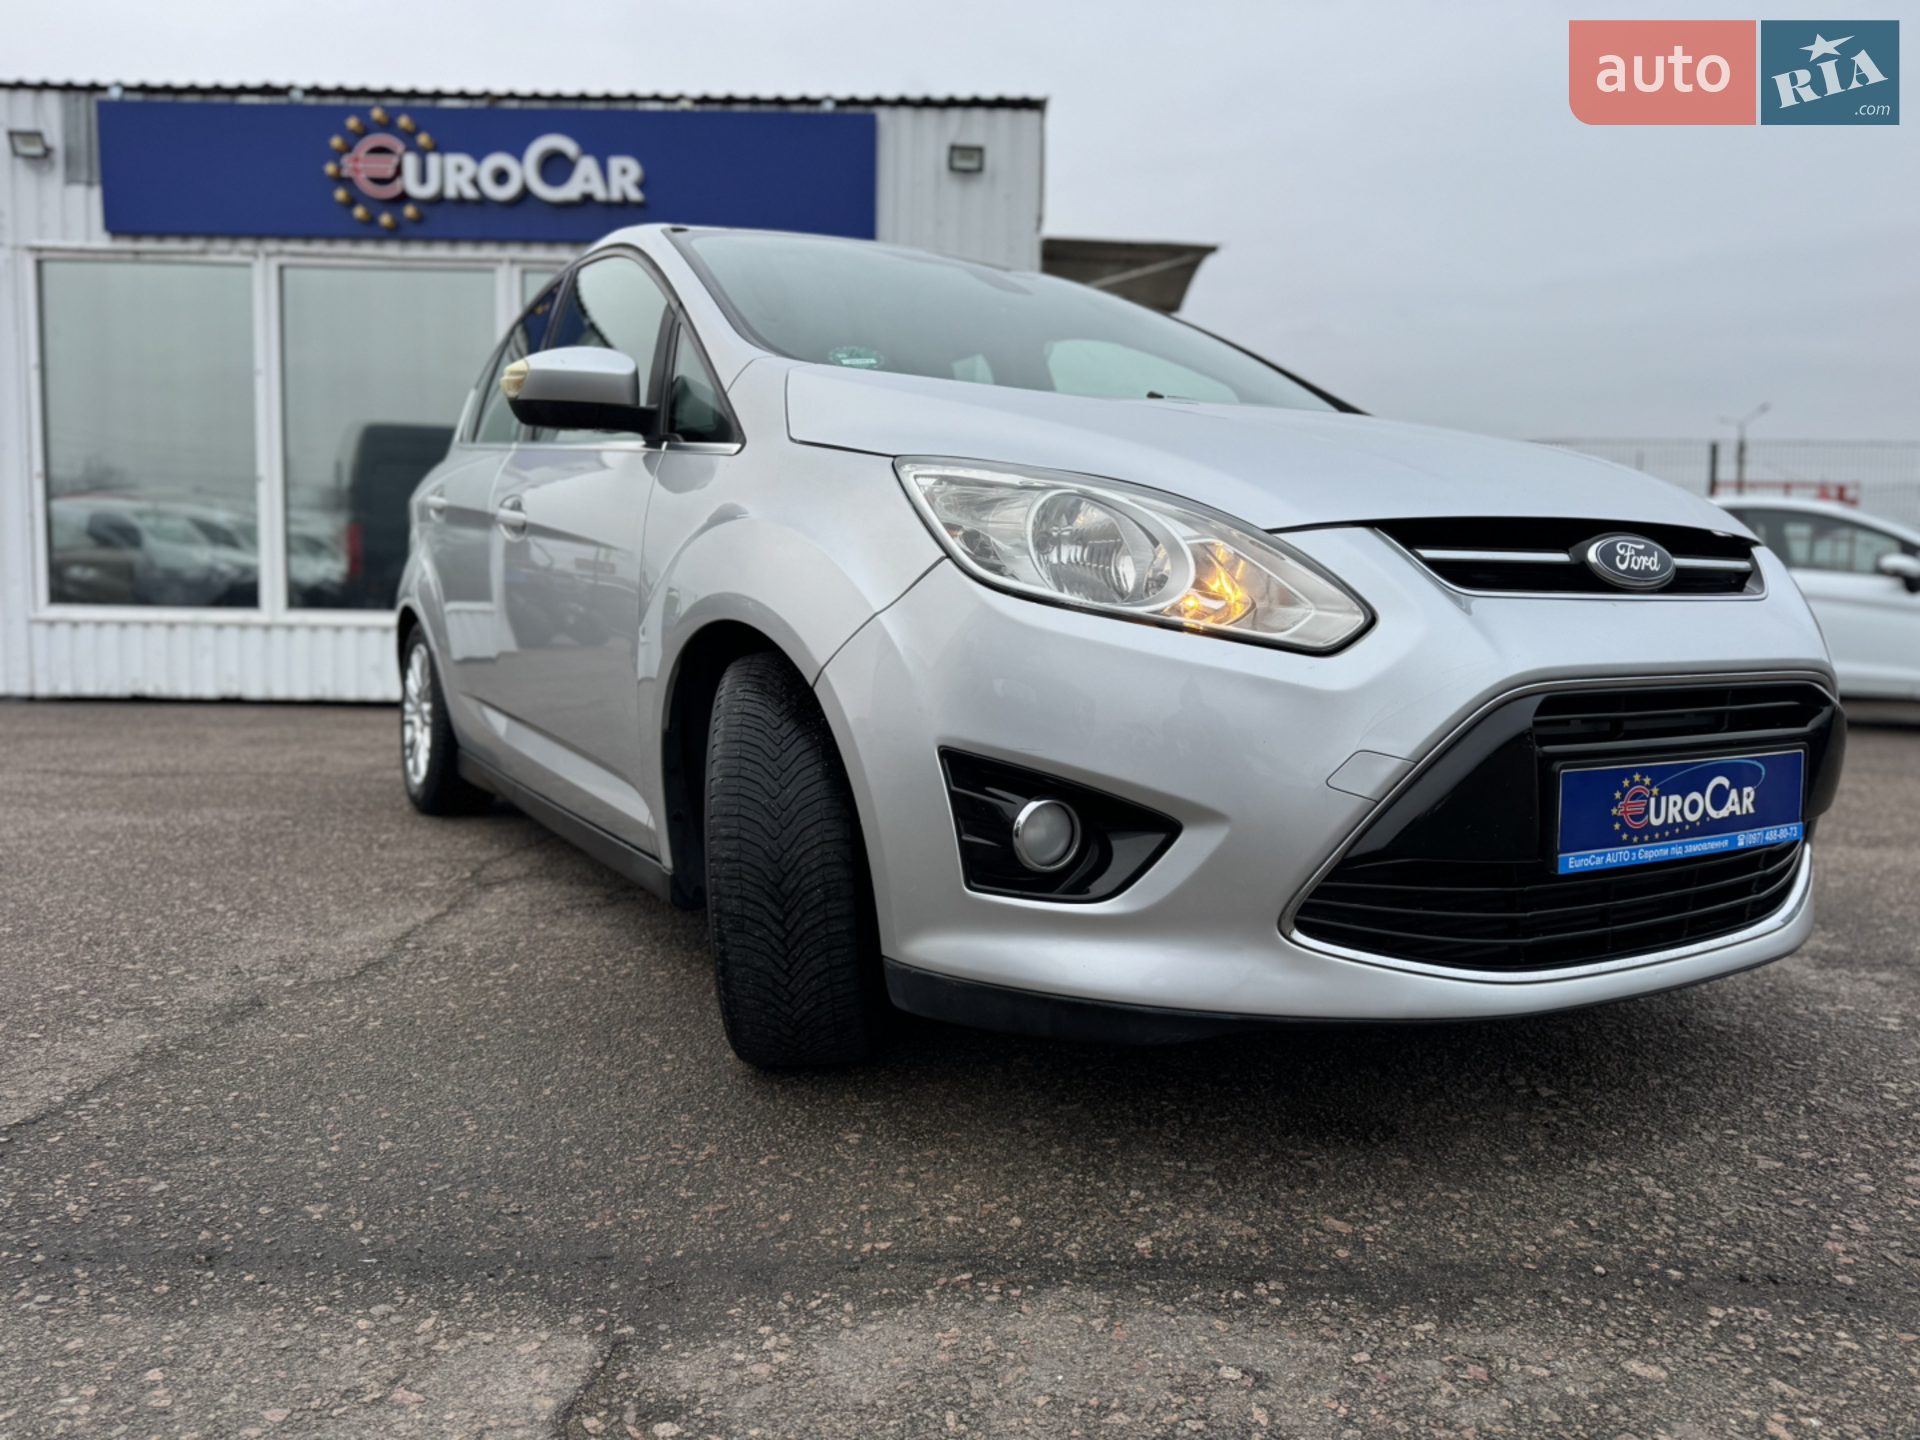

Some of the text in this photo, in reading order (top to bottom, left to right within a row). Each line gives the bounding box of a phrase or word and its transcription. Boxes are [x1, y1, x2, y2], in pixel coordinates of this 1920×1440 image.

[1615, 541, 1661, 572] Ford
[1568, 855, 1604, 869] EuroCar
[1605, 850, 1630, 864] AUTO
[1638, 848, 1669, 861] Європи
[1670, 844, 1683, 856] під
[1684, 839, 1729, 854] замовлення
